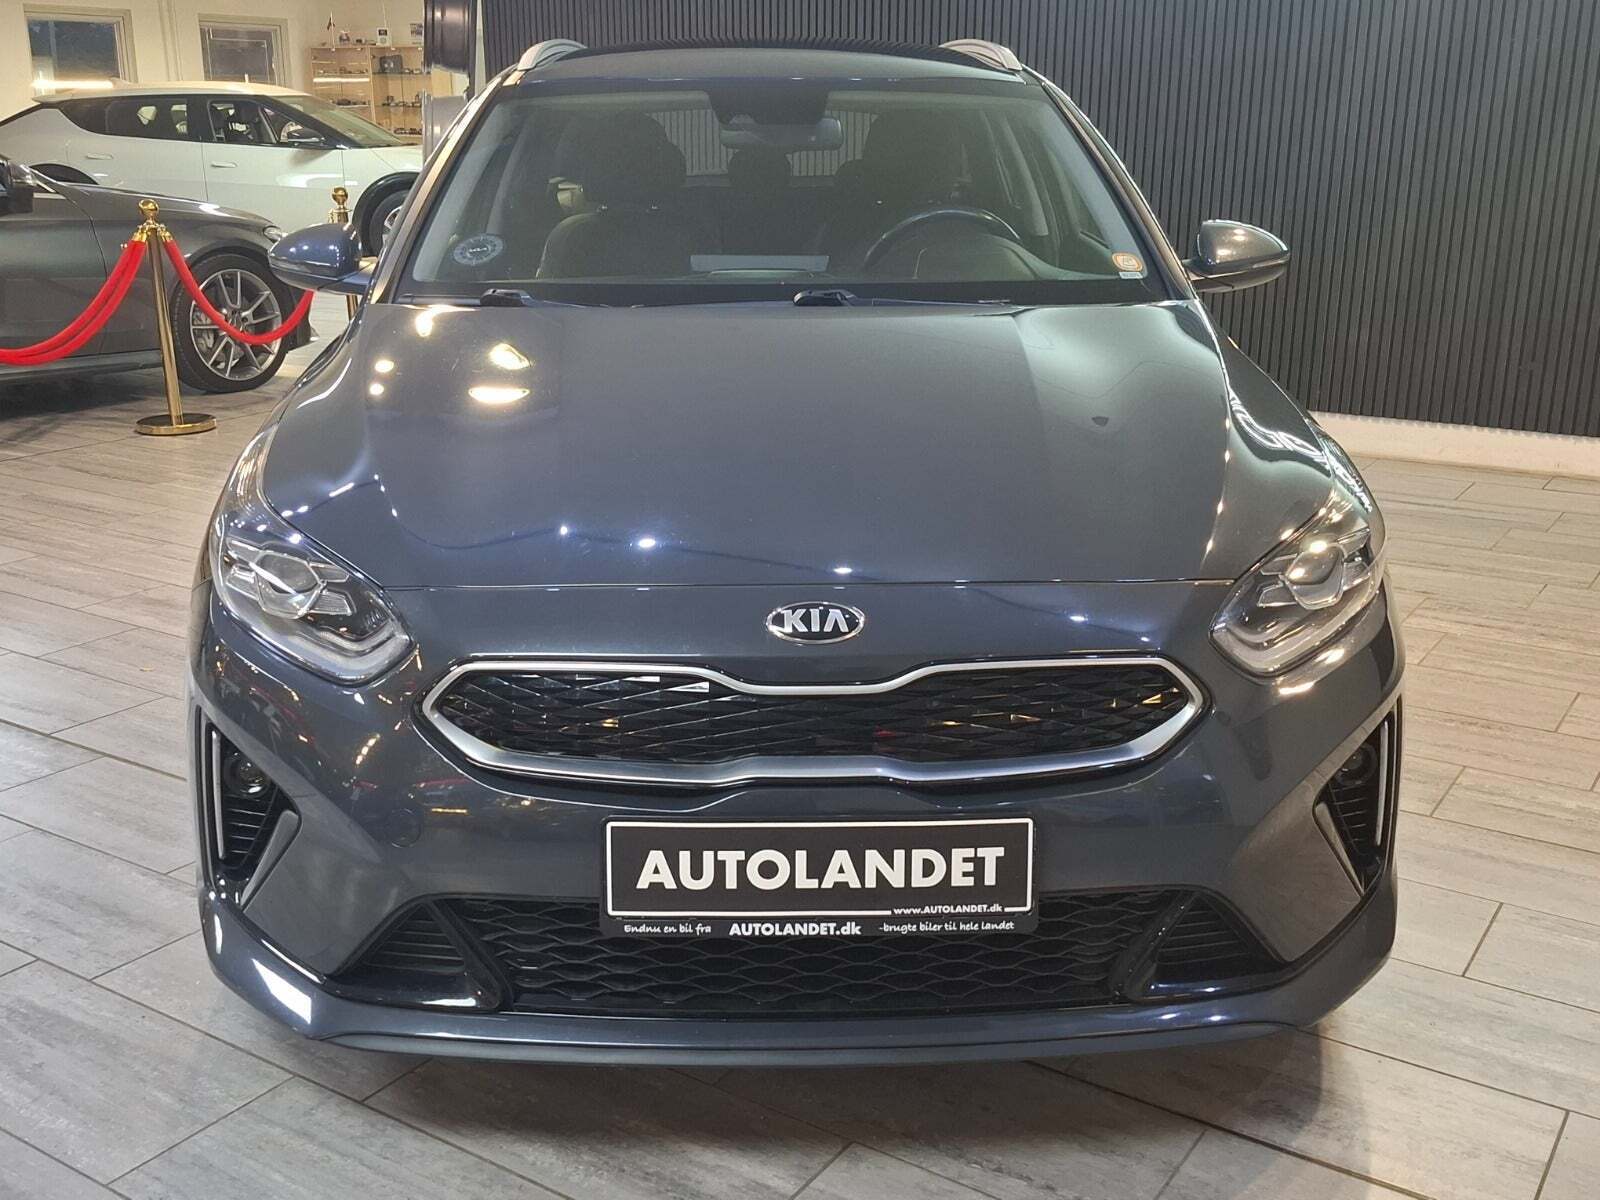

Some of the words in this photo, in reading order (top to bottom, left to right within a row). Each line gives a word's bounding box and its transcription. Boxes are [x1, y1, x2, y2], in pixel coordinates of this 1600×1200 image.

[781, 608, 849, 633] KIA
[635, 847, 1006, 891] AUTOLANDET
[893, 903, 1003, 915] www.AUTOLANDET.dk
[623, 923, 662, 934] Endnu
[663, 925, 678, 934] en
[679, 922, 694, 934] bil
[695, 923, 712, 937] fra
[728, 921, 862, 936] AUTOLANDET.dk
[919, 920, 943, 932] biler
[944, 920, 958, 931] til
[959, 919, 980, 931] hele
[981, 920, 1015, 931] landet
